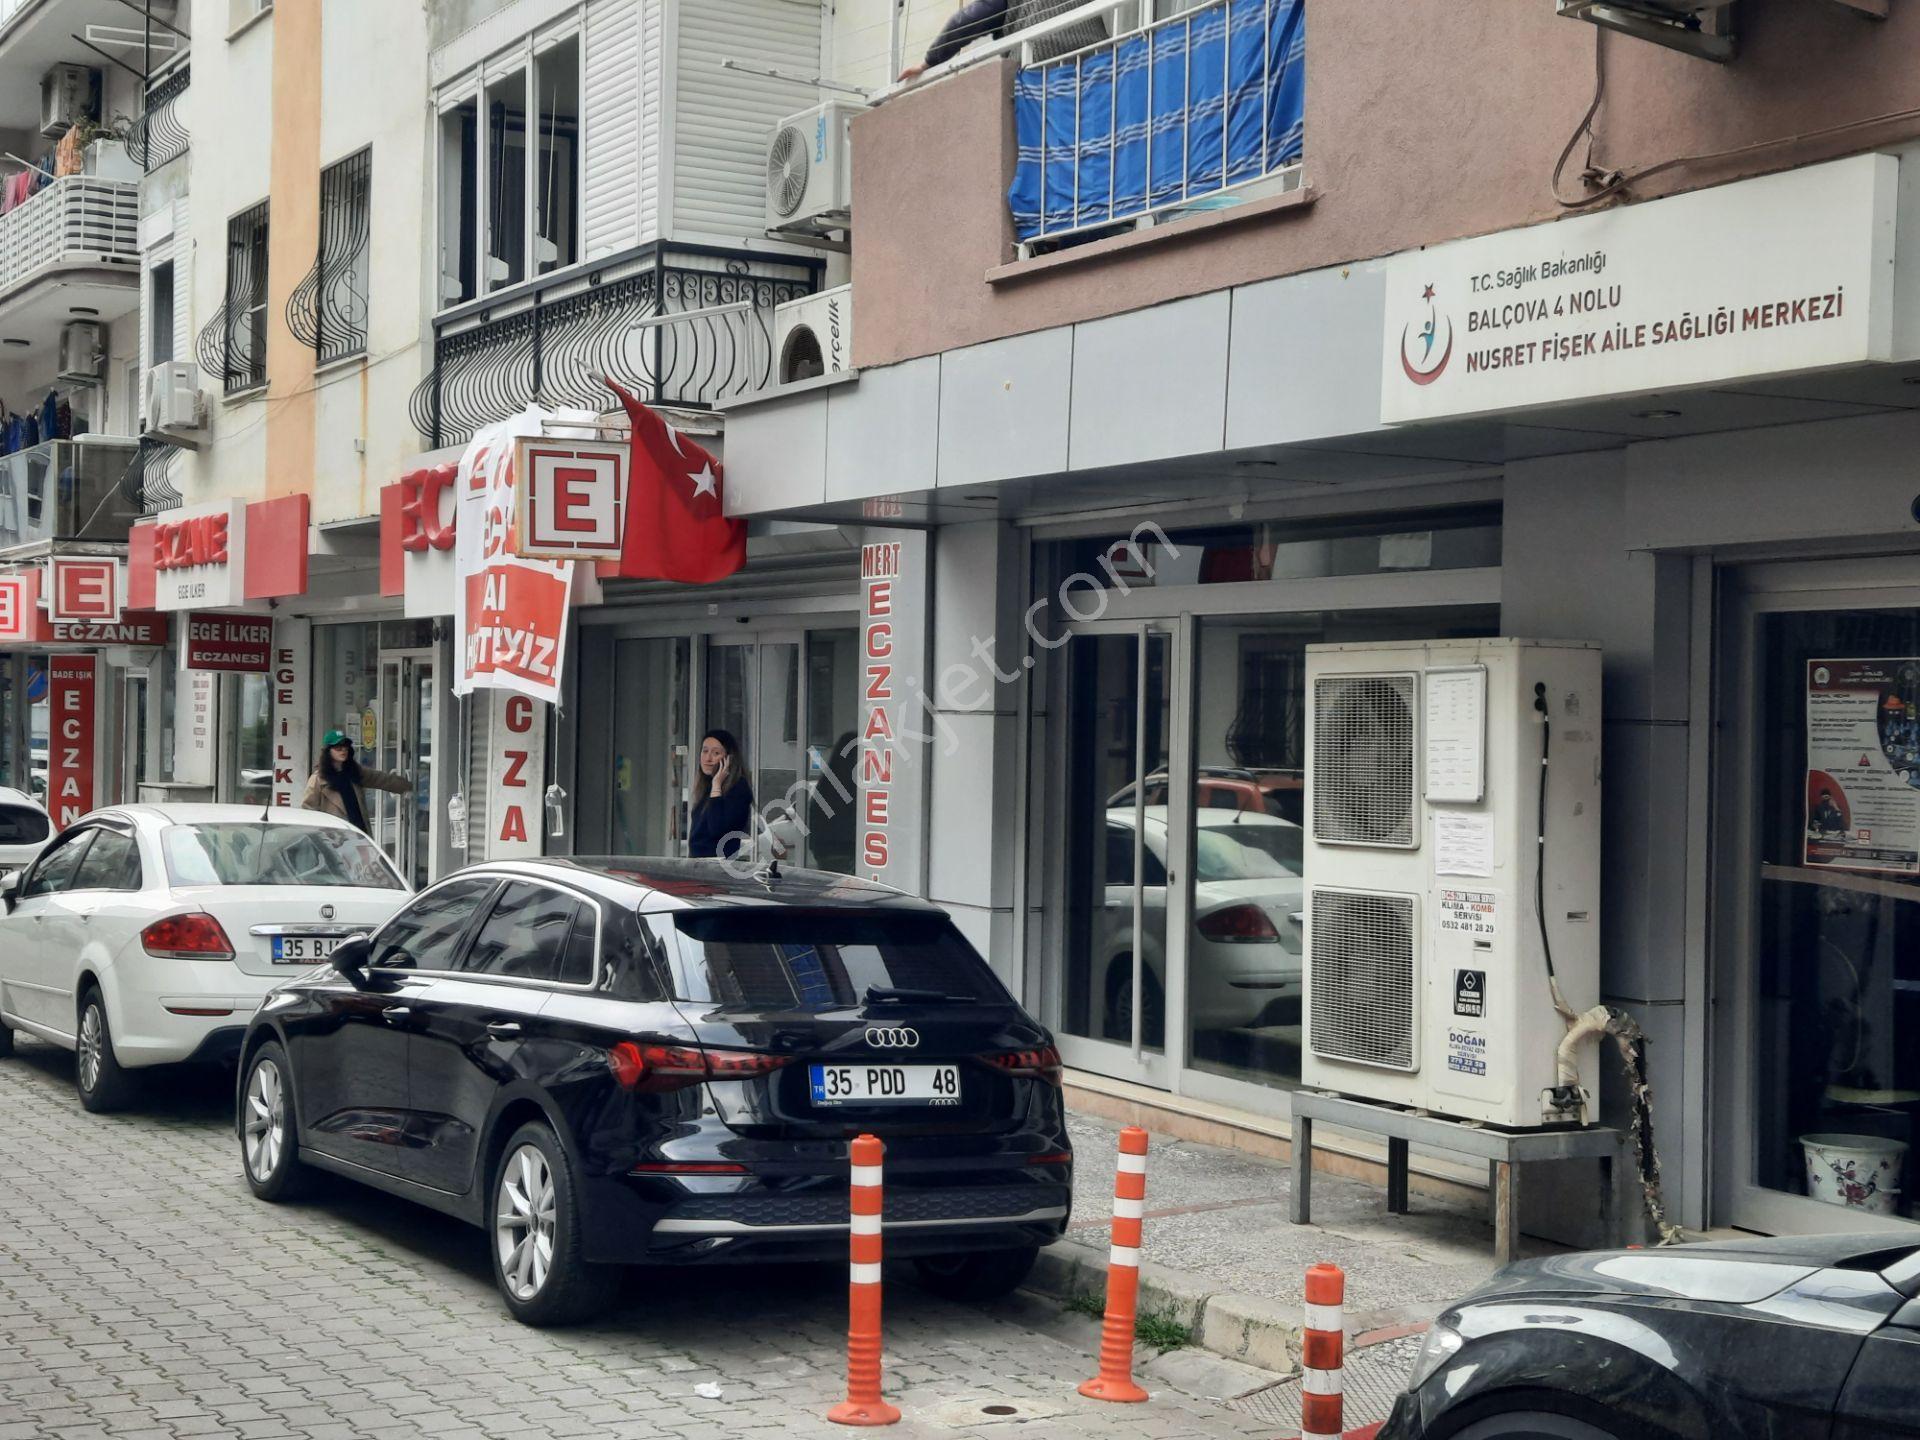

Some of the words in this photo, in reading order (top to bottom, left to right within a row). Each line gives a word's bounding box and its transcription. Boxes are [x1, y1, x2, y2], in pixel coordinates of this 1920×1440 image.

[815, 111, 826, 163] beko
[1470, 273, 1494, 293] T.C.
[1496, 264, 1537, 289] Sağlık
[1541, 251, 1606, 279] Bakanlığı
[1466, 342, 1537, 373] NUSRET
[1541, 332, 1596, 361] FİŞEK
[1601, 322, 1646, 353] AİLE
[1652, 306, 1734, 345] SAĞLIĞI
[1742, 285, 1843, 331] MERKEZİ
[1468, 298, 1548, 332] BALÇOVA
[1553, 295, 1563, 317] 4
[1570, 284, 1621, 315] NOLU
[831, 298, 842, 375] arçelik
[554, 467, 597, 532] E
[154, 512, 229, 570] ECZANE
[861, 541, 901, 579] MERT
[64, 568, 105, 612] E
[53, 624, 151, 641] ECZANE
[189, 622, 221, 641] EGE
[225, 620, 270, 643] İLKER
[52, 670, 74, 679] BADE
[192, 651, 265, 664] ECZANESİ
[276, 648, 294, 704] EGE
[861, 580, 894, 884] ECZANES
[284, 940, 304, 957] 35
[314, 940, 339, 958] BJ
[813, 1085, 824, 1094] TR
[826, 1069, 852, 1095] 35
[867, 1069, 906, 1095] PDD
[932, 1068, 957, 1095] 48
